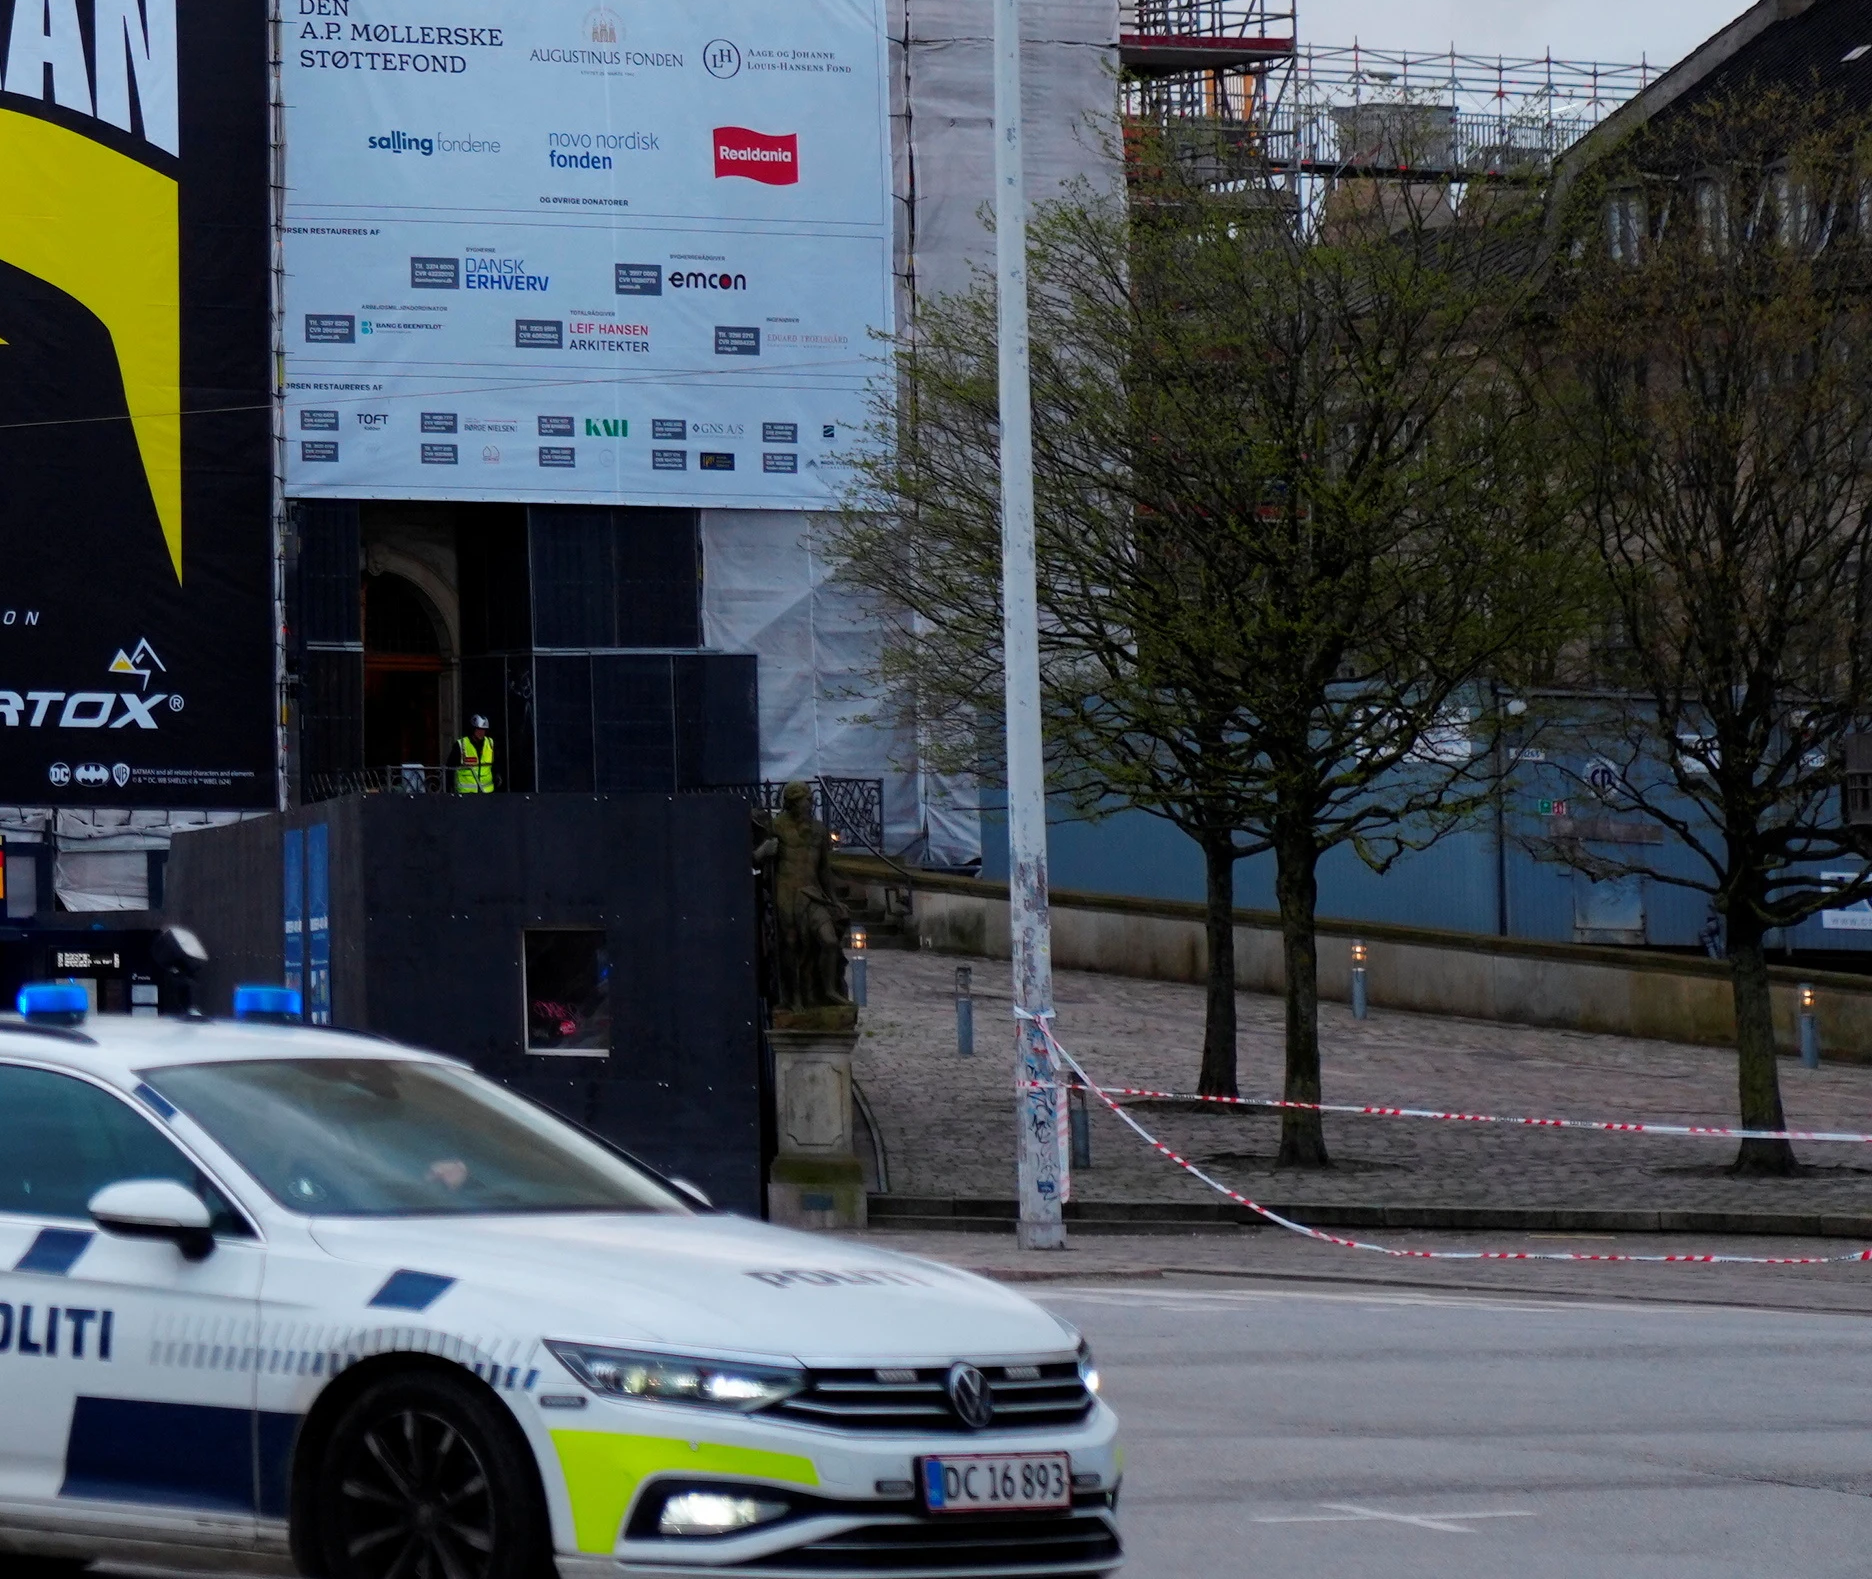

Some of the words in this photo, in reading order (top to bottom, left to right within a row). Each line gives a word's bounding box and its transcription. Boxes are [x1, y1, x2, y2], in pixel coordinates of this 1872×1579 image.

[299, 21, 342, 41] A.P.
[350, 23, 504, 47] MØLLERSKE
[300, 49, 467, 74] STØTTEFOND
[529, 48, 621, 66] AUGUSTINUS
[625, 51, 684, 68] FONDEN
[368, 130, 434, 156] salling
[437, 131, 502, 153] fondene
[548, 131, 592, 149] novo
[596, 131, 660, 151] nordisk
[548, 149, 613, 170] fonden
[719, 145, 792, 162] Realdania
[539, 196, 551, 204] OG
[552, 196, 581, 205] ØVRIGE
[582, 197, 629, 207] DONATORER
[310, 228, 368, 237] RESTAURERES
[465, 257, 526, 275] DANSK
[466, 274, 549, 291] ERHVERV
[668, 271, 747, 290] emcon
[569, 323, 595, 334] LEIF
[598, 323, 649, 336] HANSEN
[569, 339, 650, 353] ARKITEKTER
[313, 383, 371, 392] RESTAURERES
[372, 384, 383, 392] AF
[357, 413, 389, 425] TOFT
[487, 423, 515, 433] NIELSEN
[701, 423, 724, 434] GNS
[726, 423, 744, 435] A/S
[51, 766, 70, 783] DC
[133, 768, 155, 776] BATMAN
[156, 768, 167, 777] and
[220, 770, 231, 778] and
[742, 1270, 934, 1289] POLITI
[943, 1467, 980, 1500] DC
[988, 1465, 1016, 1500] 16
[1021, 1463, 1066, 1500] 893
